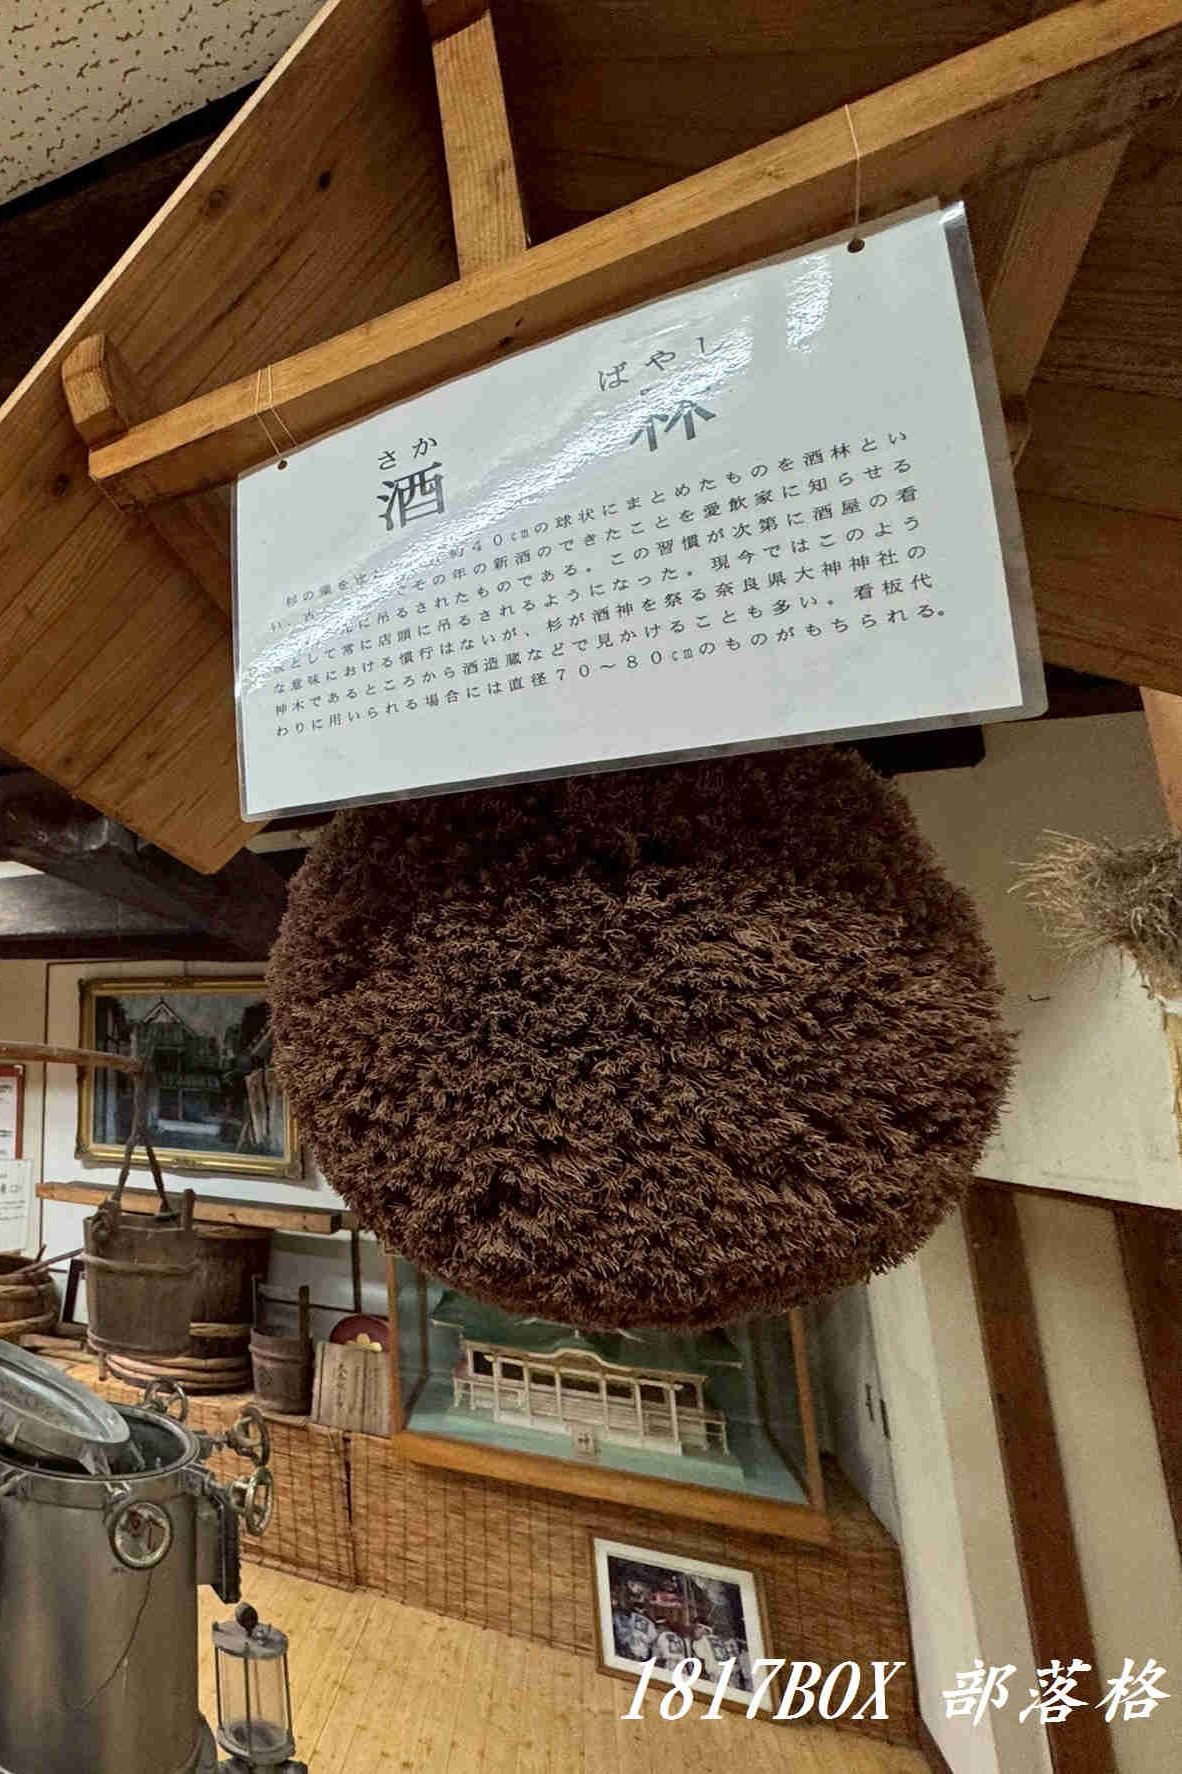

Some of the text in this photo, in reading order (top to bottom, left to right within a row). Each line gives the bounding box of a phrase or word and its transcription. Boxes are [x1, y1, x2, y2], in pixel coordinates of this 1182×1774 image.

[377, 336, 724, 471] さか ばやし
[376, 461, 445, 532] 酒
